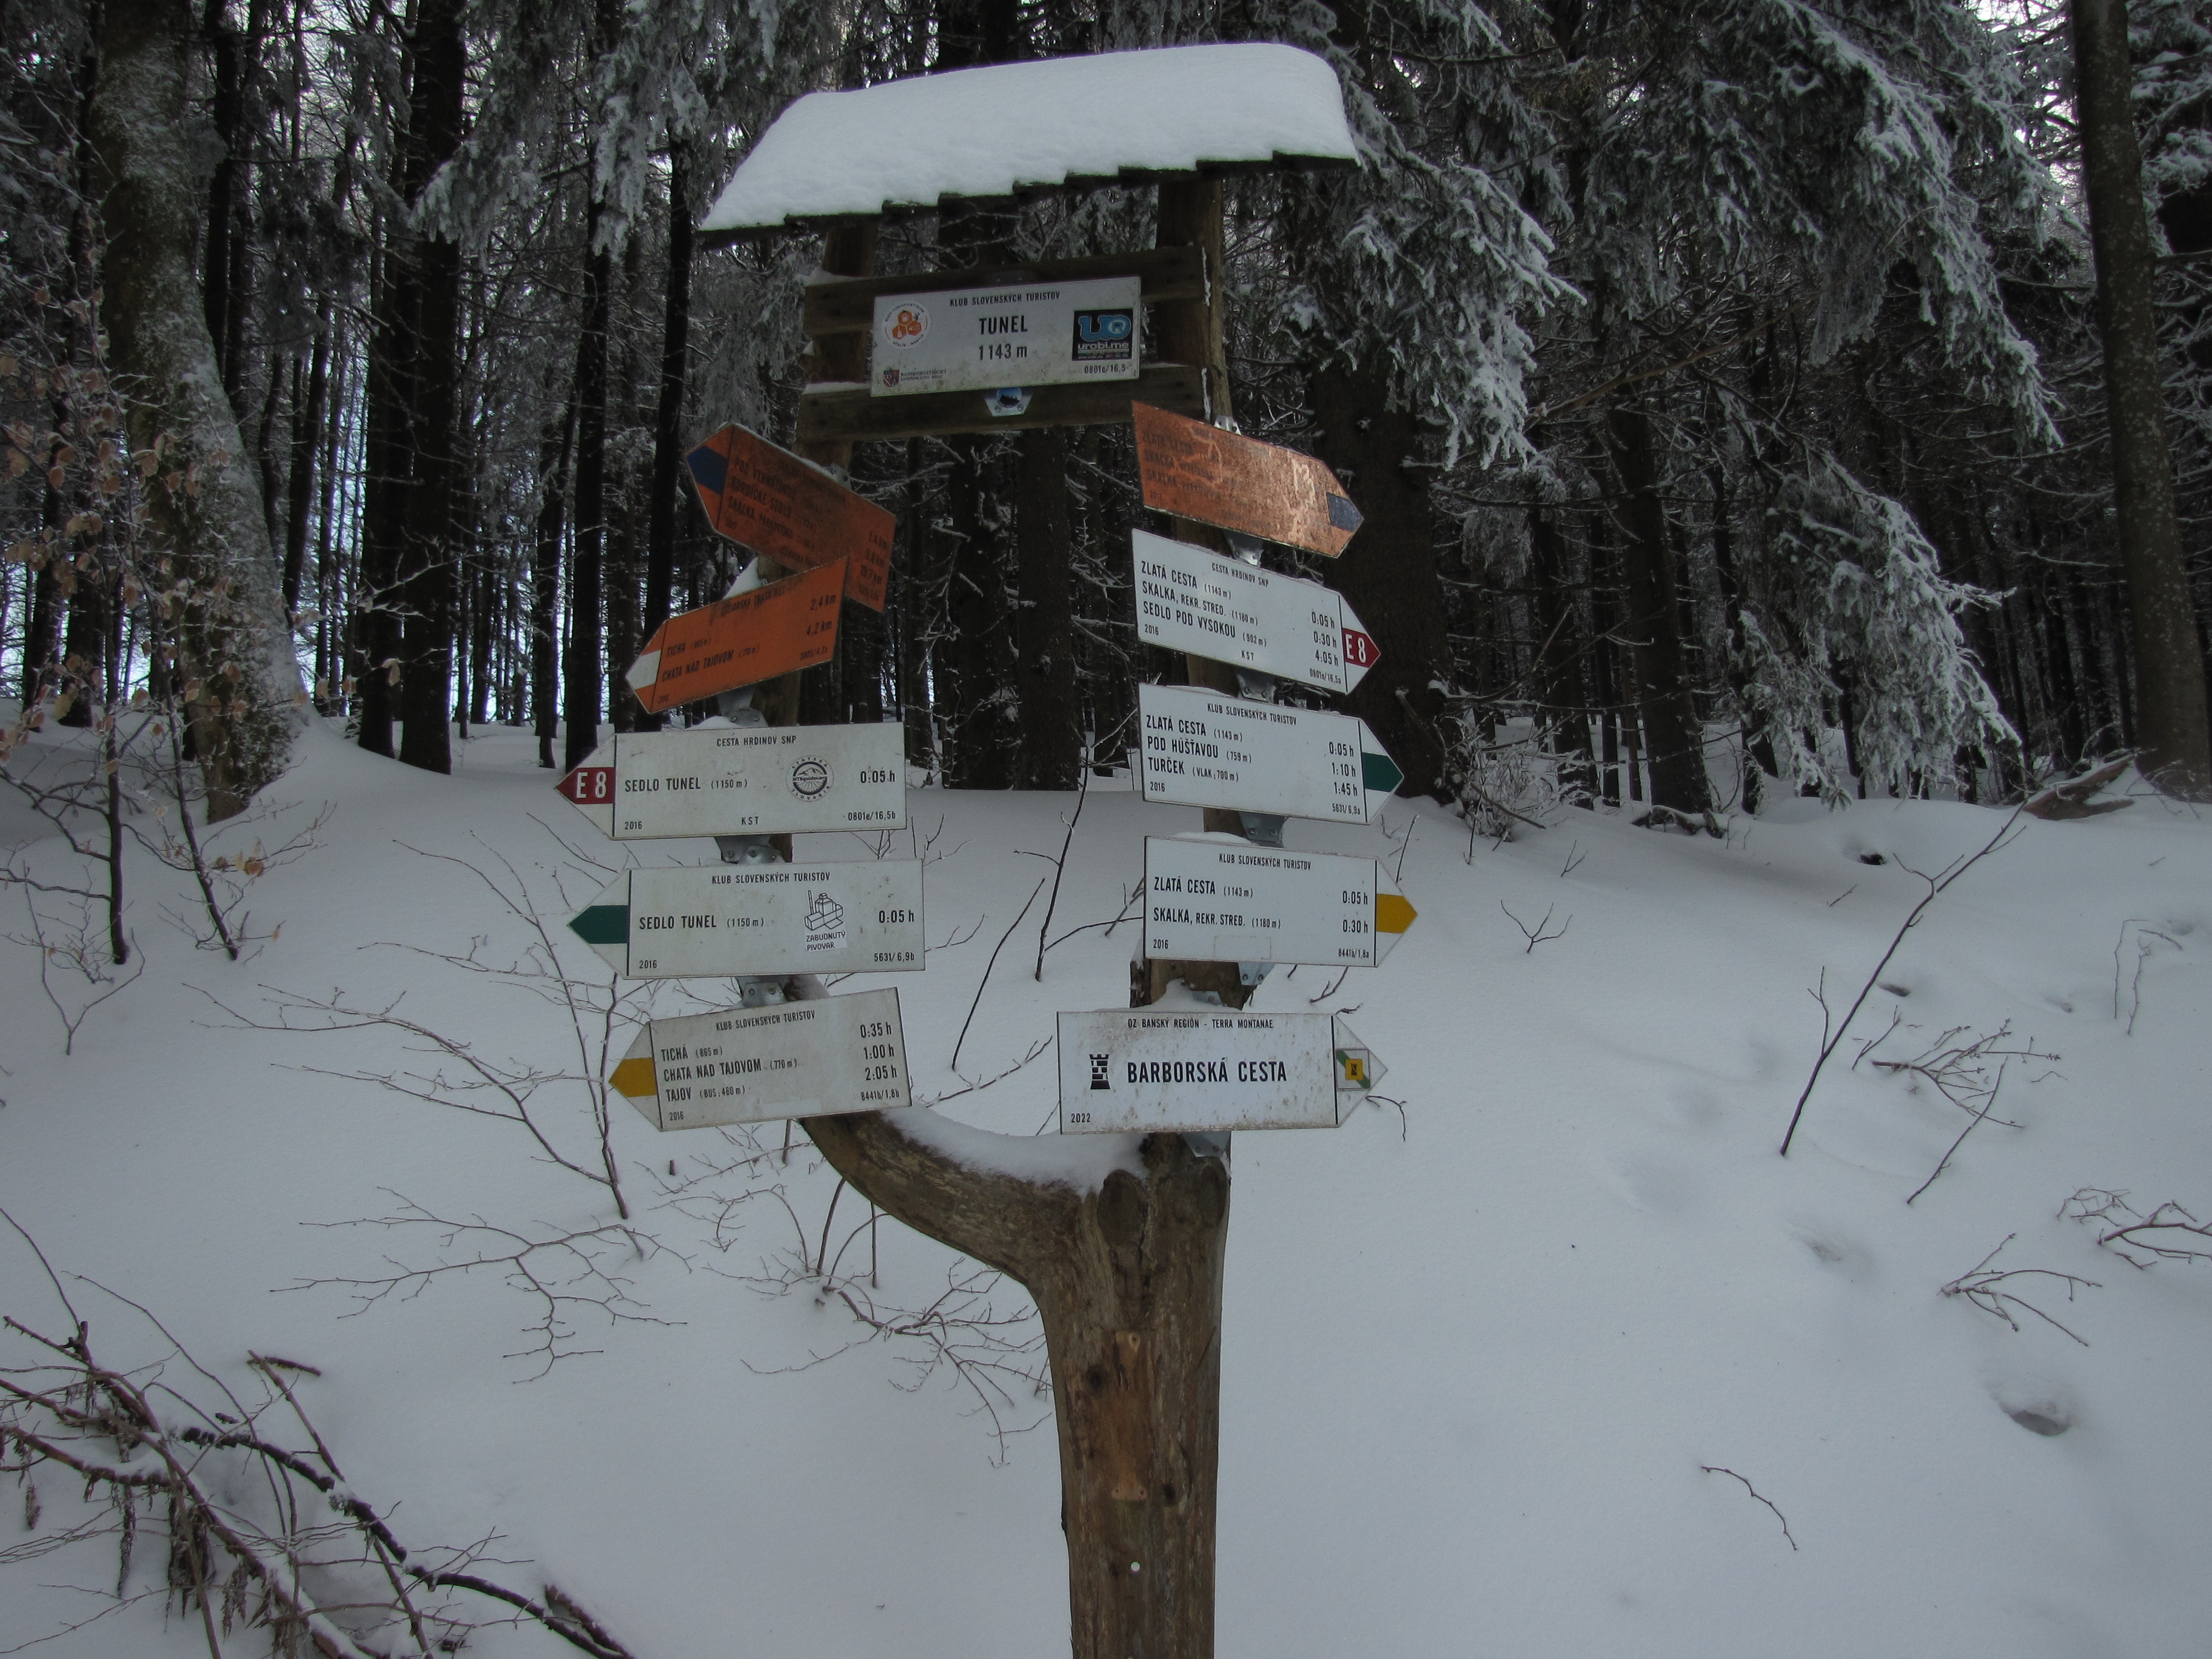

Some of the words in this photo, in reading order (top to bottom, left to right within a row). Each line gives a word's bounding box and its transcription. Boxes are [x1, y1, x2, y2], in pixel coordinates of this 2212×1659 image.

[950, 298, 968, 307] KLUB
[972, 293, 1022, 306] SLOVENSKÝCH
[1026, 292, 1060, 301] TURISTOV
[979, 315, 1028, 335] TUNEL
[1016, 345, 1027, 358] m
[1141, 560, 1167, 580] ZLATÁ
[1171, 570, 1198, 589] CESTA
[1212, 562, 1230, 576] CESTA
[1231, 568, 1256, 584] HRDINOV
[1258, 576, 1270, 588] SNP
[824, 594, 836, 605] km
[1142, 581, 1178, 605] SKALKA,
[1181, 594, 1201, 609] REKR.
[820, 620, 832, 632] km
[1143, 600, 1171, 620] SEDLO
[1176, 611, 1194, 626] POD
[1198, 617, 1236, 638] VYSOKOU
[1311, 611, 1329, 628] 0:05
[1330, 617, 1335, 629] h
[1144, 624, 1159, 636] 2016
[1313, 631, 1331, 647] 0:30
[1332, 637, 1337, 649] h
[1241, 650, 1255, 662] KST
[1346, 636, 1354, 659] E
[1357, 636, 1366, 663] 8
[1315, 649, 1333, 665] 4:05
[1333, 655, 1339, 666] h
[662, 665, 682, 682] CHATA
[686, 661, 700, 675] NAD
[1207, 703, 1224, 714] KLUB
[1226, 705, 1267, 721] SLOVENSKÝCH
[1270, 712, 1297, 726] TURISTOV
[1145, 714, 1174, 731] ZLATÁ
[1179, 720, 1207, 737] CESTA
[716, 737, 740, 746] CESTA
[743, 736, 777, 746] HRDINOV
[781, 736, 797, 745] SNP
[1147, 735, 1167, 751] POD
[1171, 737, 1219, 759] HÚŠŤAVOU
[1328, 742, 1348, 757] 0:05
[1349, 745, 1355, 757] h
[1148, 756, 1185, 775] TURČEK
[1332, 762, 1349, 777] 1:10
[1350, 765, 1356, 777] h
[860, 770, 886, 784] 0:05
[888, 769, 896, 783] h
[576, 773, 588, 799] E
[595, 771, 607, 799] 8
[625, 779, 660, 792] SEDLO
[666, 777, 702, 791] TUNEL
[1150, 782, 1165, 792] 2016
[1334, 782, 1351, 796] 1:45
[1353, 784, 1358, 796] h
[624, 820, 643, 830] 2016
[741, 816, 760, 826] KST
[1219, 853, 1235, 863] KLUB
[1238, 856, 1280, 868] SLOVENSKÝCH
[1283, 859, 1312, 870] TURISTOV
[712, 875, 731, 885] KLUB
[736, 872, 789, 883] SLOVENSKÝCH
[794, 872, 830, 882] TURISTOV
[1153, 876, 1182, 893] ZLATÁ
[1187, 879, 1216, 894] CESTA
[1342, 891, 1361, 904] 0:05
[1362, 893, 1368, 905] h
[638, 917, 675, 930] SEDLO
[682, 915, 717, 928] TUNEL
[878, 911, 905, 923] 0:05
[908, 910, 915, 922] h
[1153, 908, 1193, 925] SKALKA,
[1196, 913, 1217, 924] REKR.
[1342, 920, 1362, 933] 0:30
[1362, 921, 1368, 933] h
[806, 930, 846, 942] ZABUDNUTÝ
[806, 942, 835, 951] PIVOVAR
[1153, 939, 1168, 949] 2016
[638, 960, 657, 970] 2016
[716, 1020, 732, 1031] KLUB
[735, 1013, 781, 1029] SLOVENSKÝCH
[783, 1010, 816, 1022] TURISTOV
[1128, 1019, 1137, 1028] OZ
[1142, 1017, 1170, 1028] BANSKÝ
[1173, 1017, 1199, 1028] REGIÓN
[1212, 1019, 1233, 1028] TERRA
[1237, 1018, 1273, 1028] MONTANAE
[860, 1024, 883, 1039] 0:35
[885, 1024, 892, 1035] h
[660, 1044, 688, 1062] TICHÁ
[863, 1046, 886, 1060] 1:00
[886, 1044, 894, 1057] h
[663, 1067, 692, 1082] CHATA
[697, 1065, 715, 1079] NAD
[719, 1058, 762, 1076] TAJOVOM
[865, 1067, 888, 1081] 2:05
[890, 1065, 897, 1078] h
[1127, 1057, 1228, 1083] BARBORSKÁ
[1238, 1061, 1287, 1082] CESTA
[665, 1087, 691, 1102] TAJOV
[669, 1111, 685, 1121] 2016
[1071, 1113, 1091, 1124] 2022
